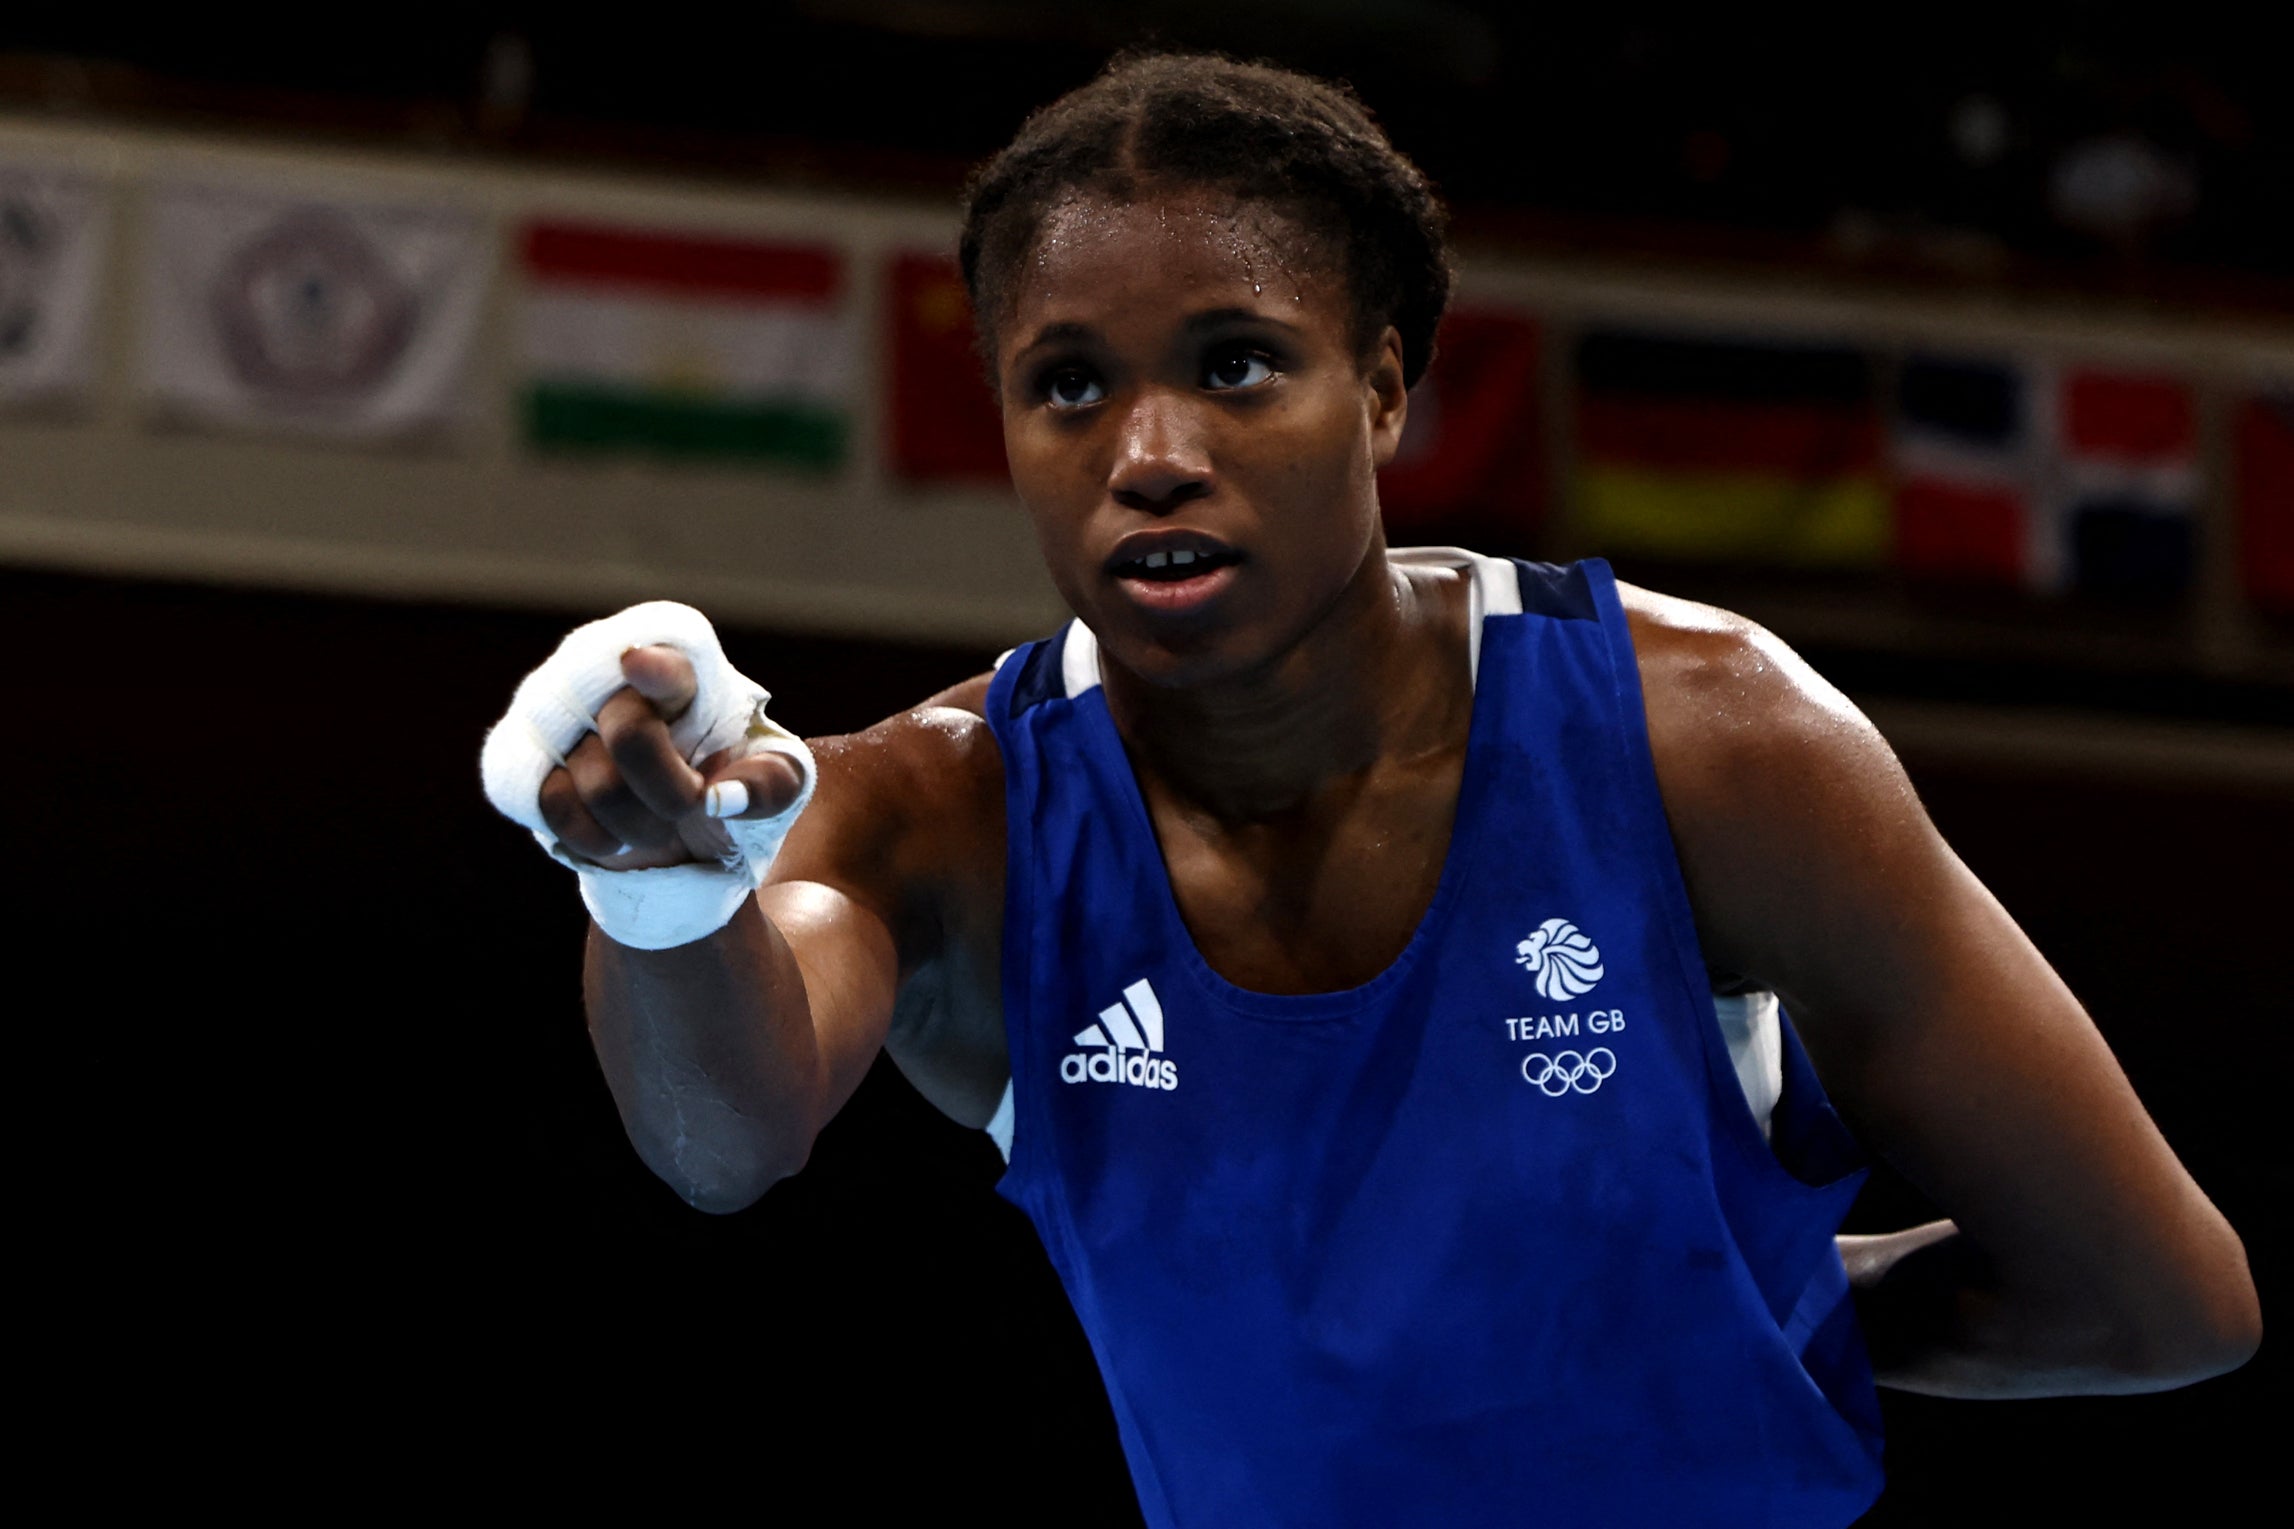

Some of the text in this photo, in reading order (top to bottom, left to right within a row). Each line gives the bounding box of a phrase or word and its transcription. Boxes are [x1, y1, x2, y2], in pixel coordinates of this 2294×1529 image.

[1505, 1009, 1626, 1041] TEAM GB
[1060, 1045, 1178, 1091] adidas
